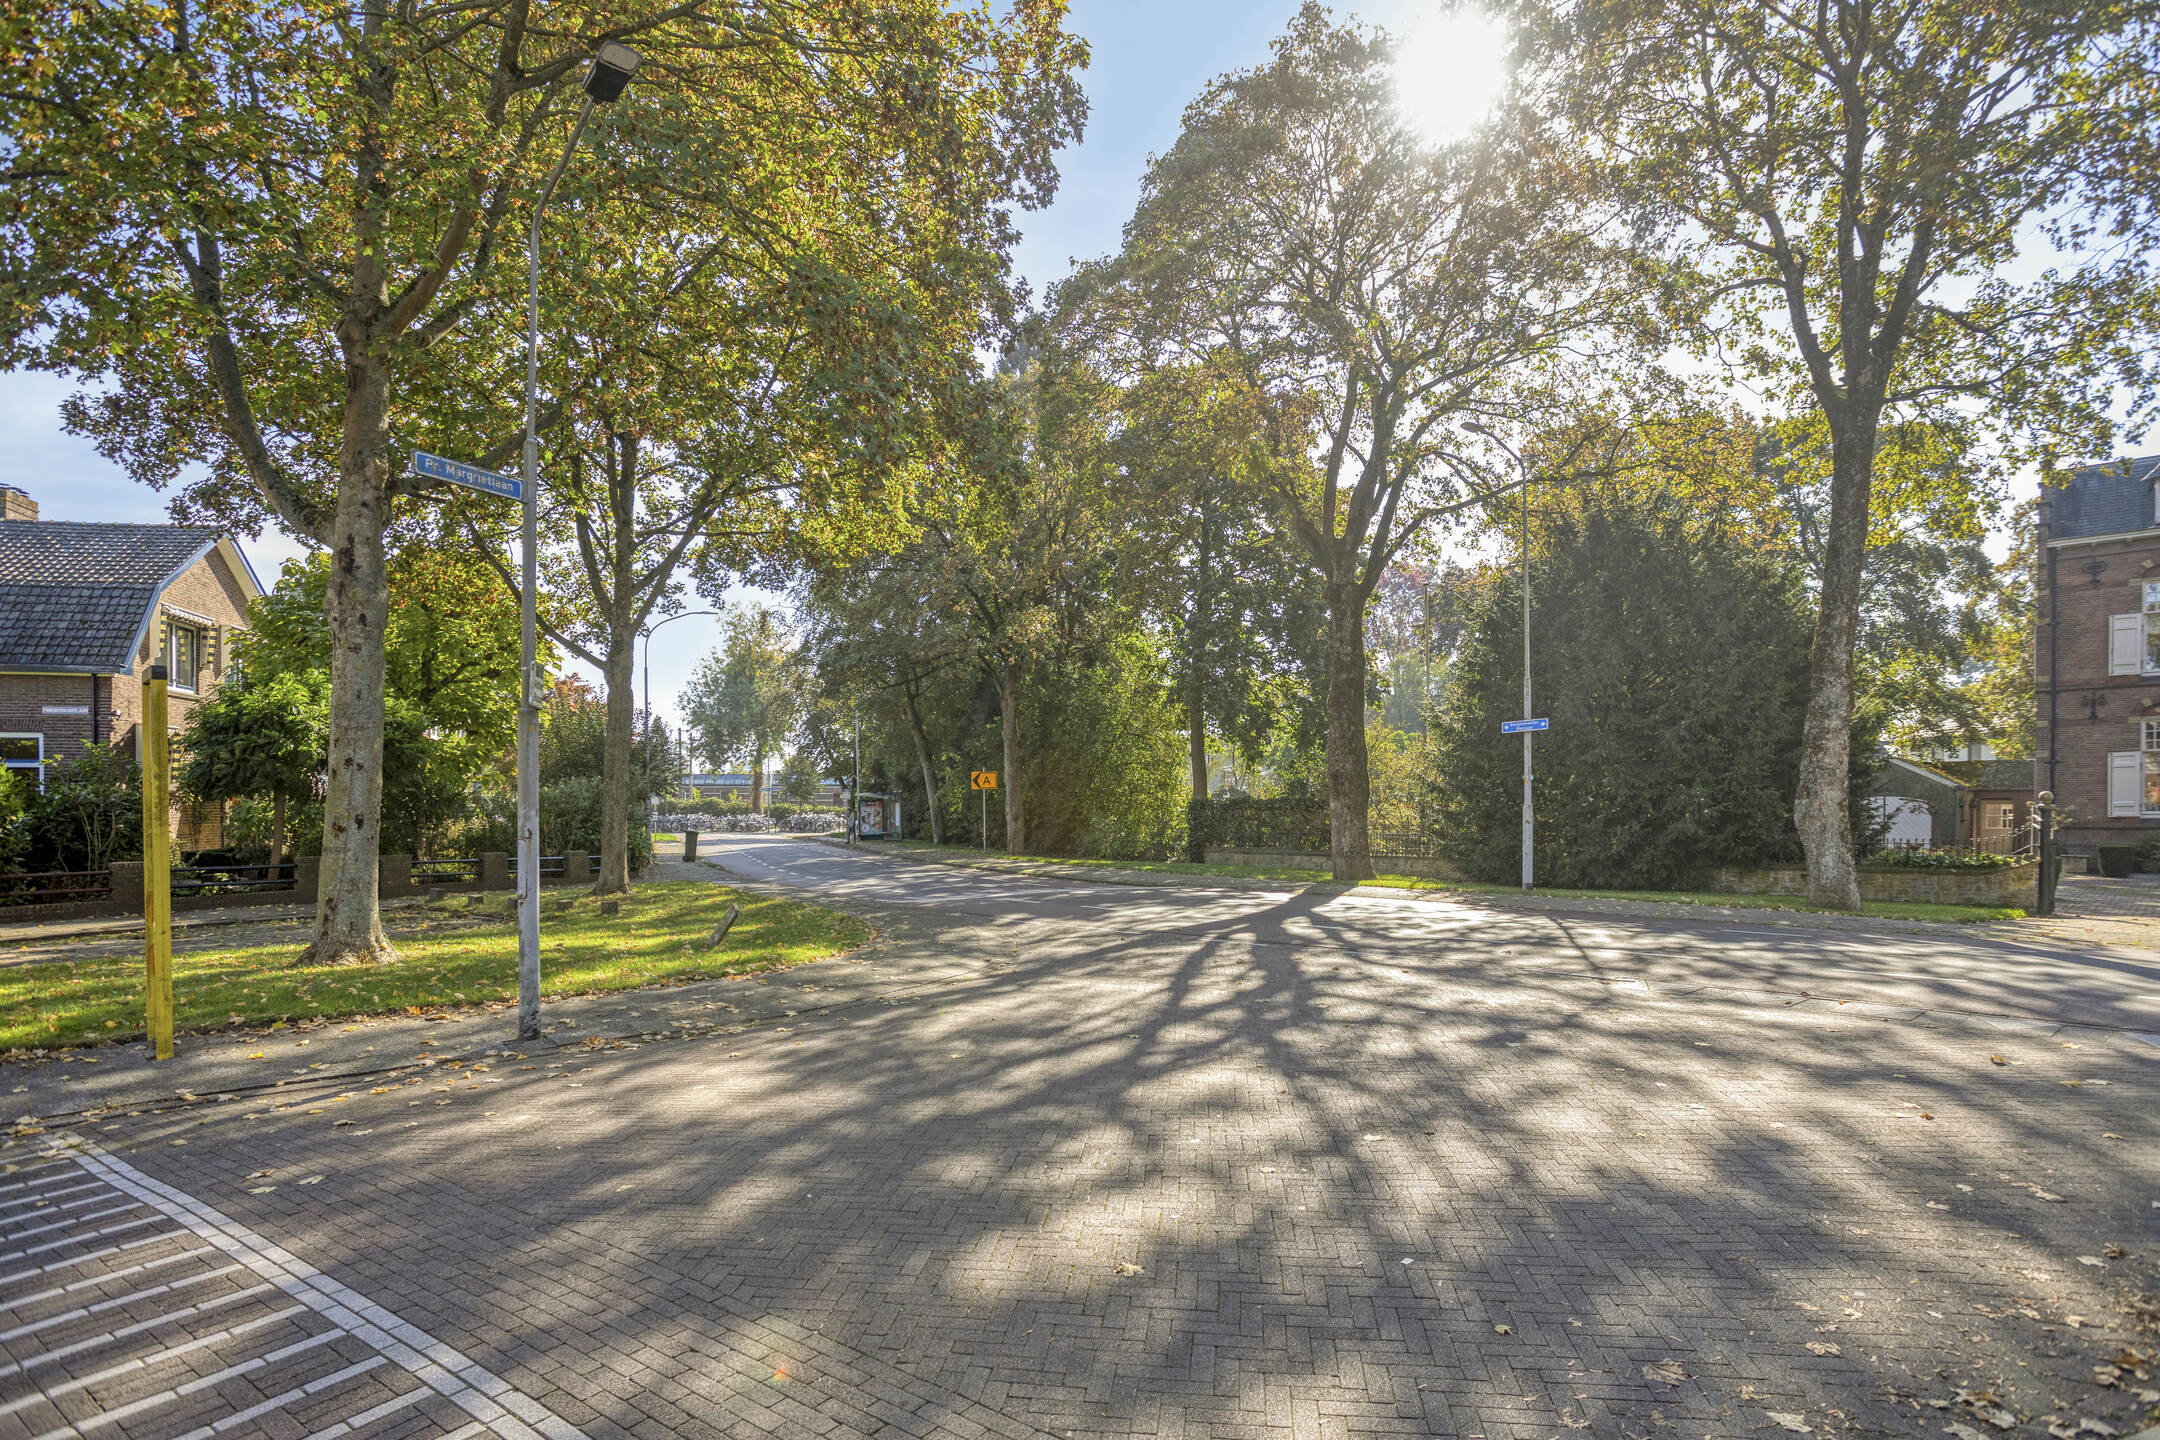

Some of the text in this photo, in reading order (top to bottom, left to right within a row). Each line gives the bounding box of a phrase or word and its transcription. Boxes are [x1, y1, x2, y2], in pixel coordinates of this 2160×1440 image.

[425, 458, 513, 492] Pr. Margrietlaan
[983, 776, 990, 784] A
